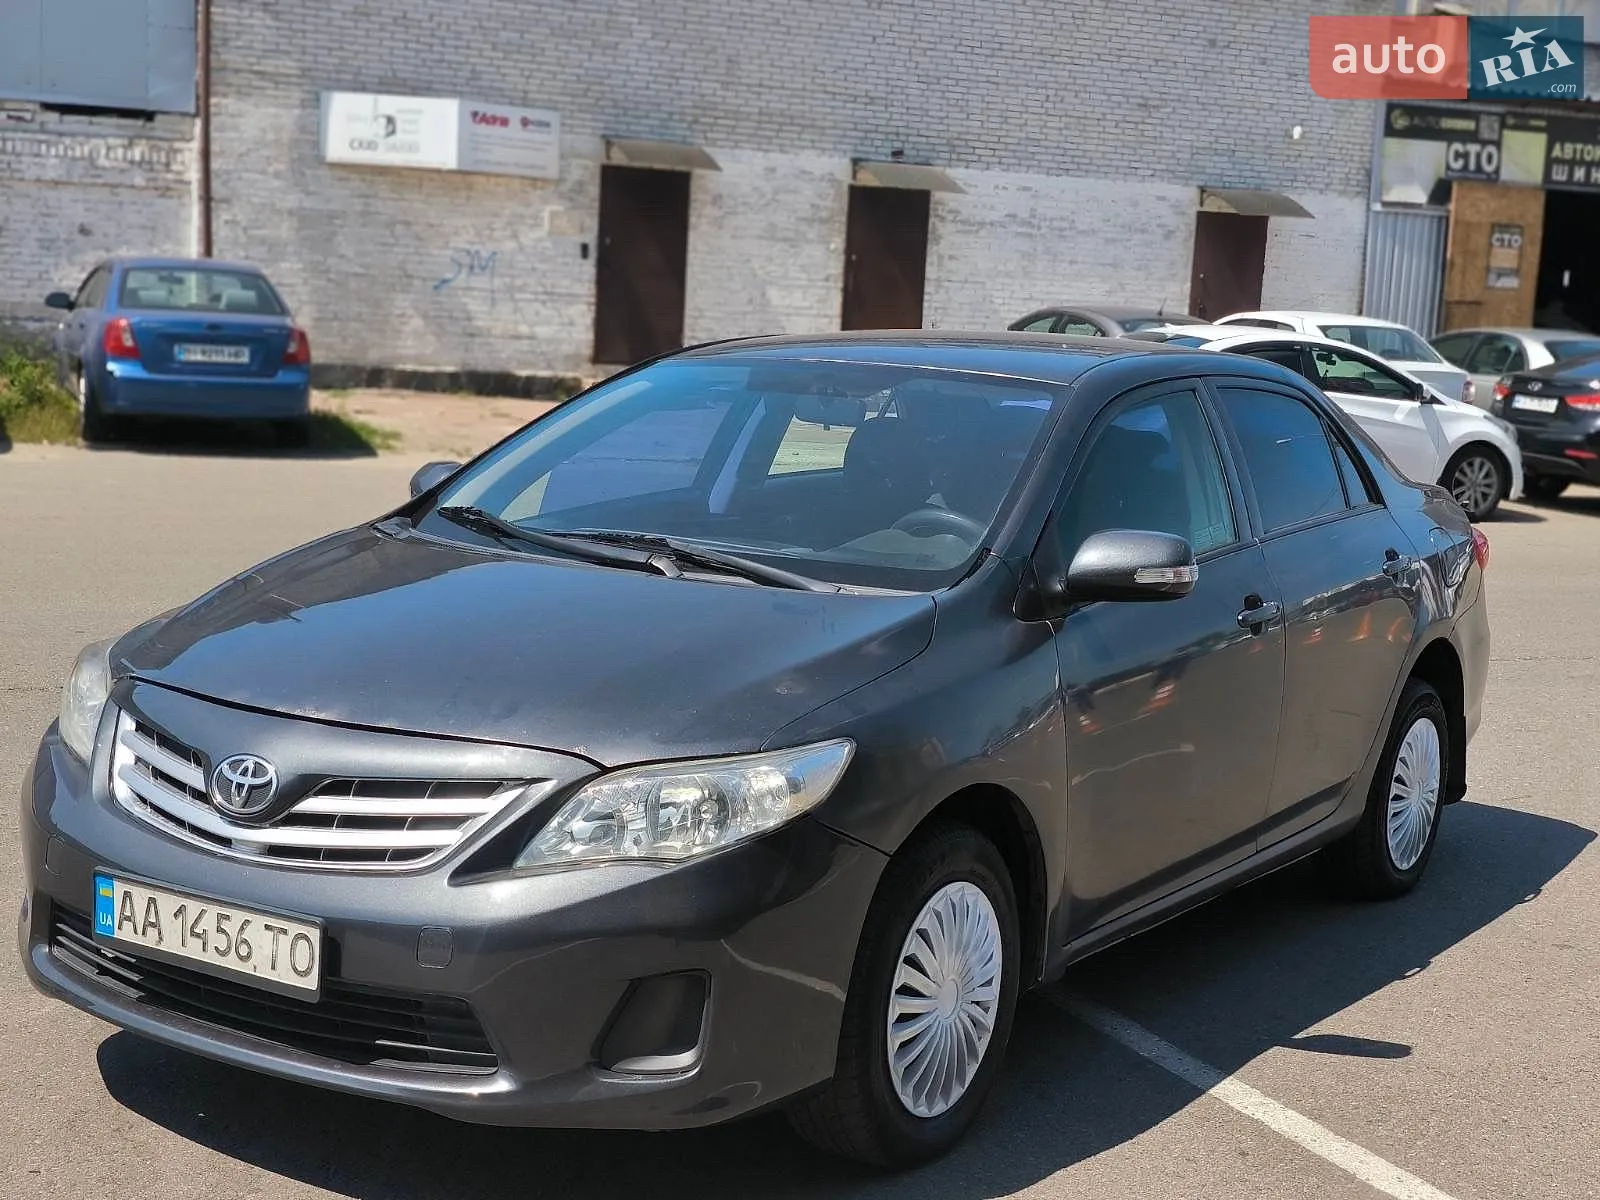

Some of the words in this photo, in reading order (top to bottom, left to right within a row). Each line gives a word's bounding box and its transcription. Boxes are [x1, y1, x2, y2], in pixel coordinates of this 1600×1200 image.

[1448, 141, 1499, 173] СТО
[1491, 233, 1522, 248] СТО
[99, 912, 113, 928] UA
[117, 889, 164, 944] AA
[173, 903, 253, 963] 1456
[264, 923, 315, 978] TO
